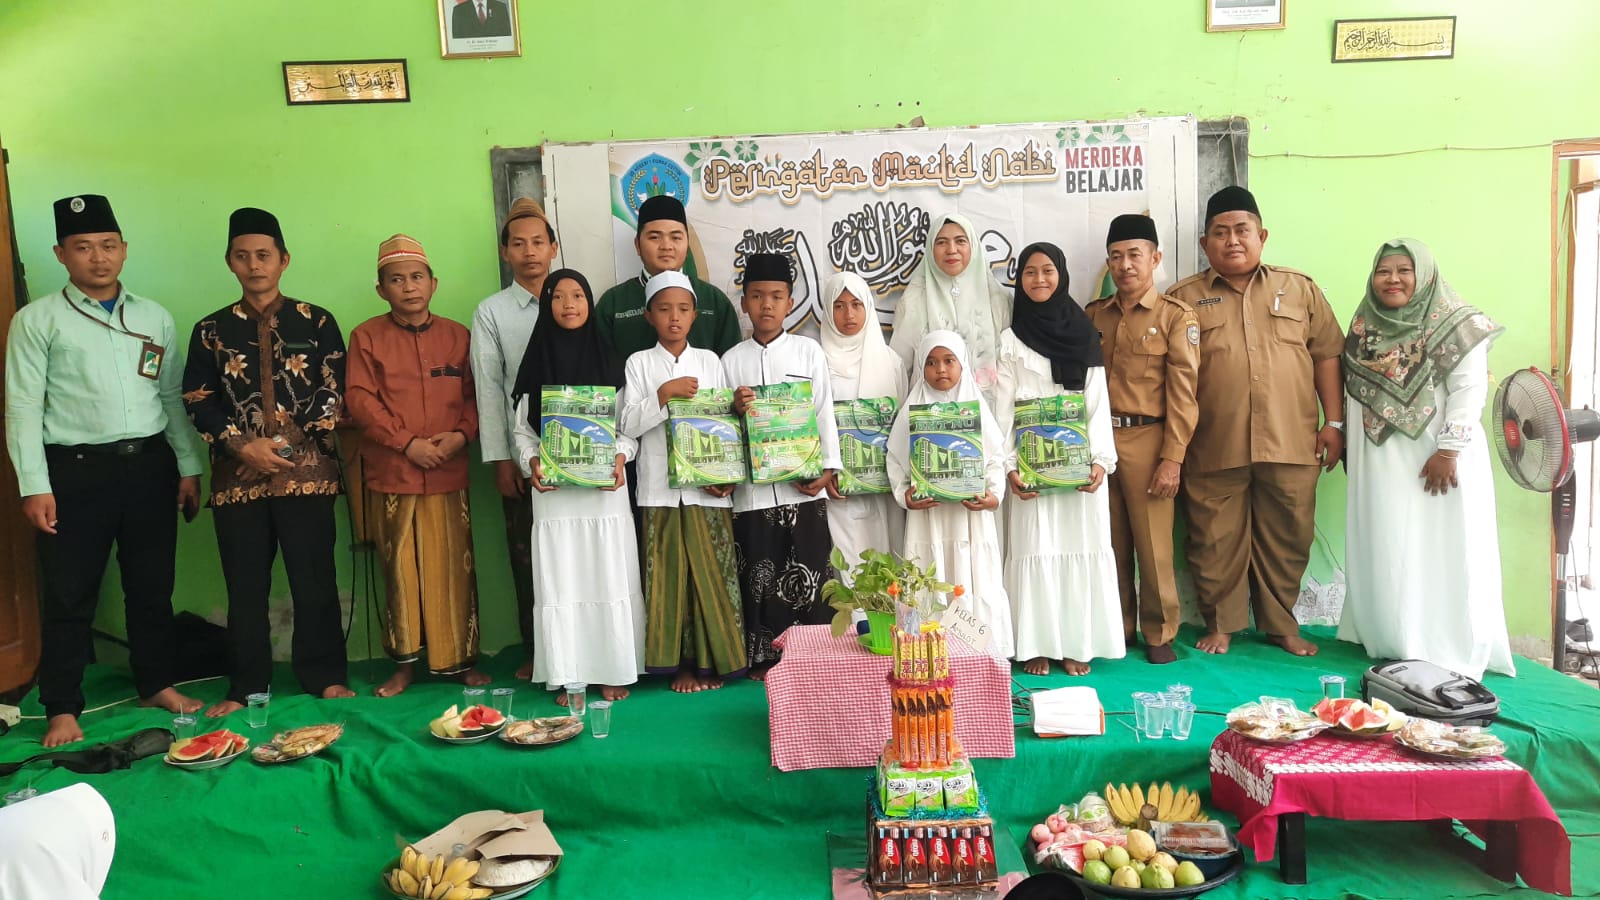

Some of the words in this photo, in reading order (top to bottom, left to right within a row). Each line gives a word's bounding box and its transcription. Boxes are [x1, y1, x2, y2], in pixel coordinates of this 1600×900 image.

[703, 147, 868, 199] Peringatan
[872, 142, 977, 187] Maulid
[981, 139, 1057, 183] Nabi
[1065, 145, 1144, 170] MERDEKA
[1065, 168, 1144, 194] BELAJAR
[953, 605, 977, 628] KELAS
[978, 623, 989, 636] 6
